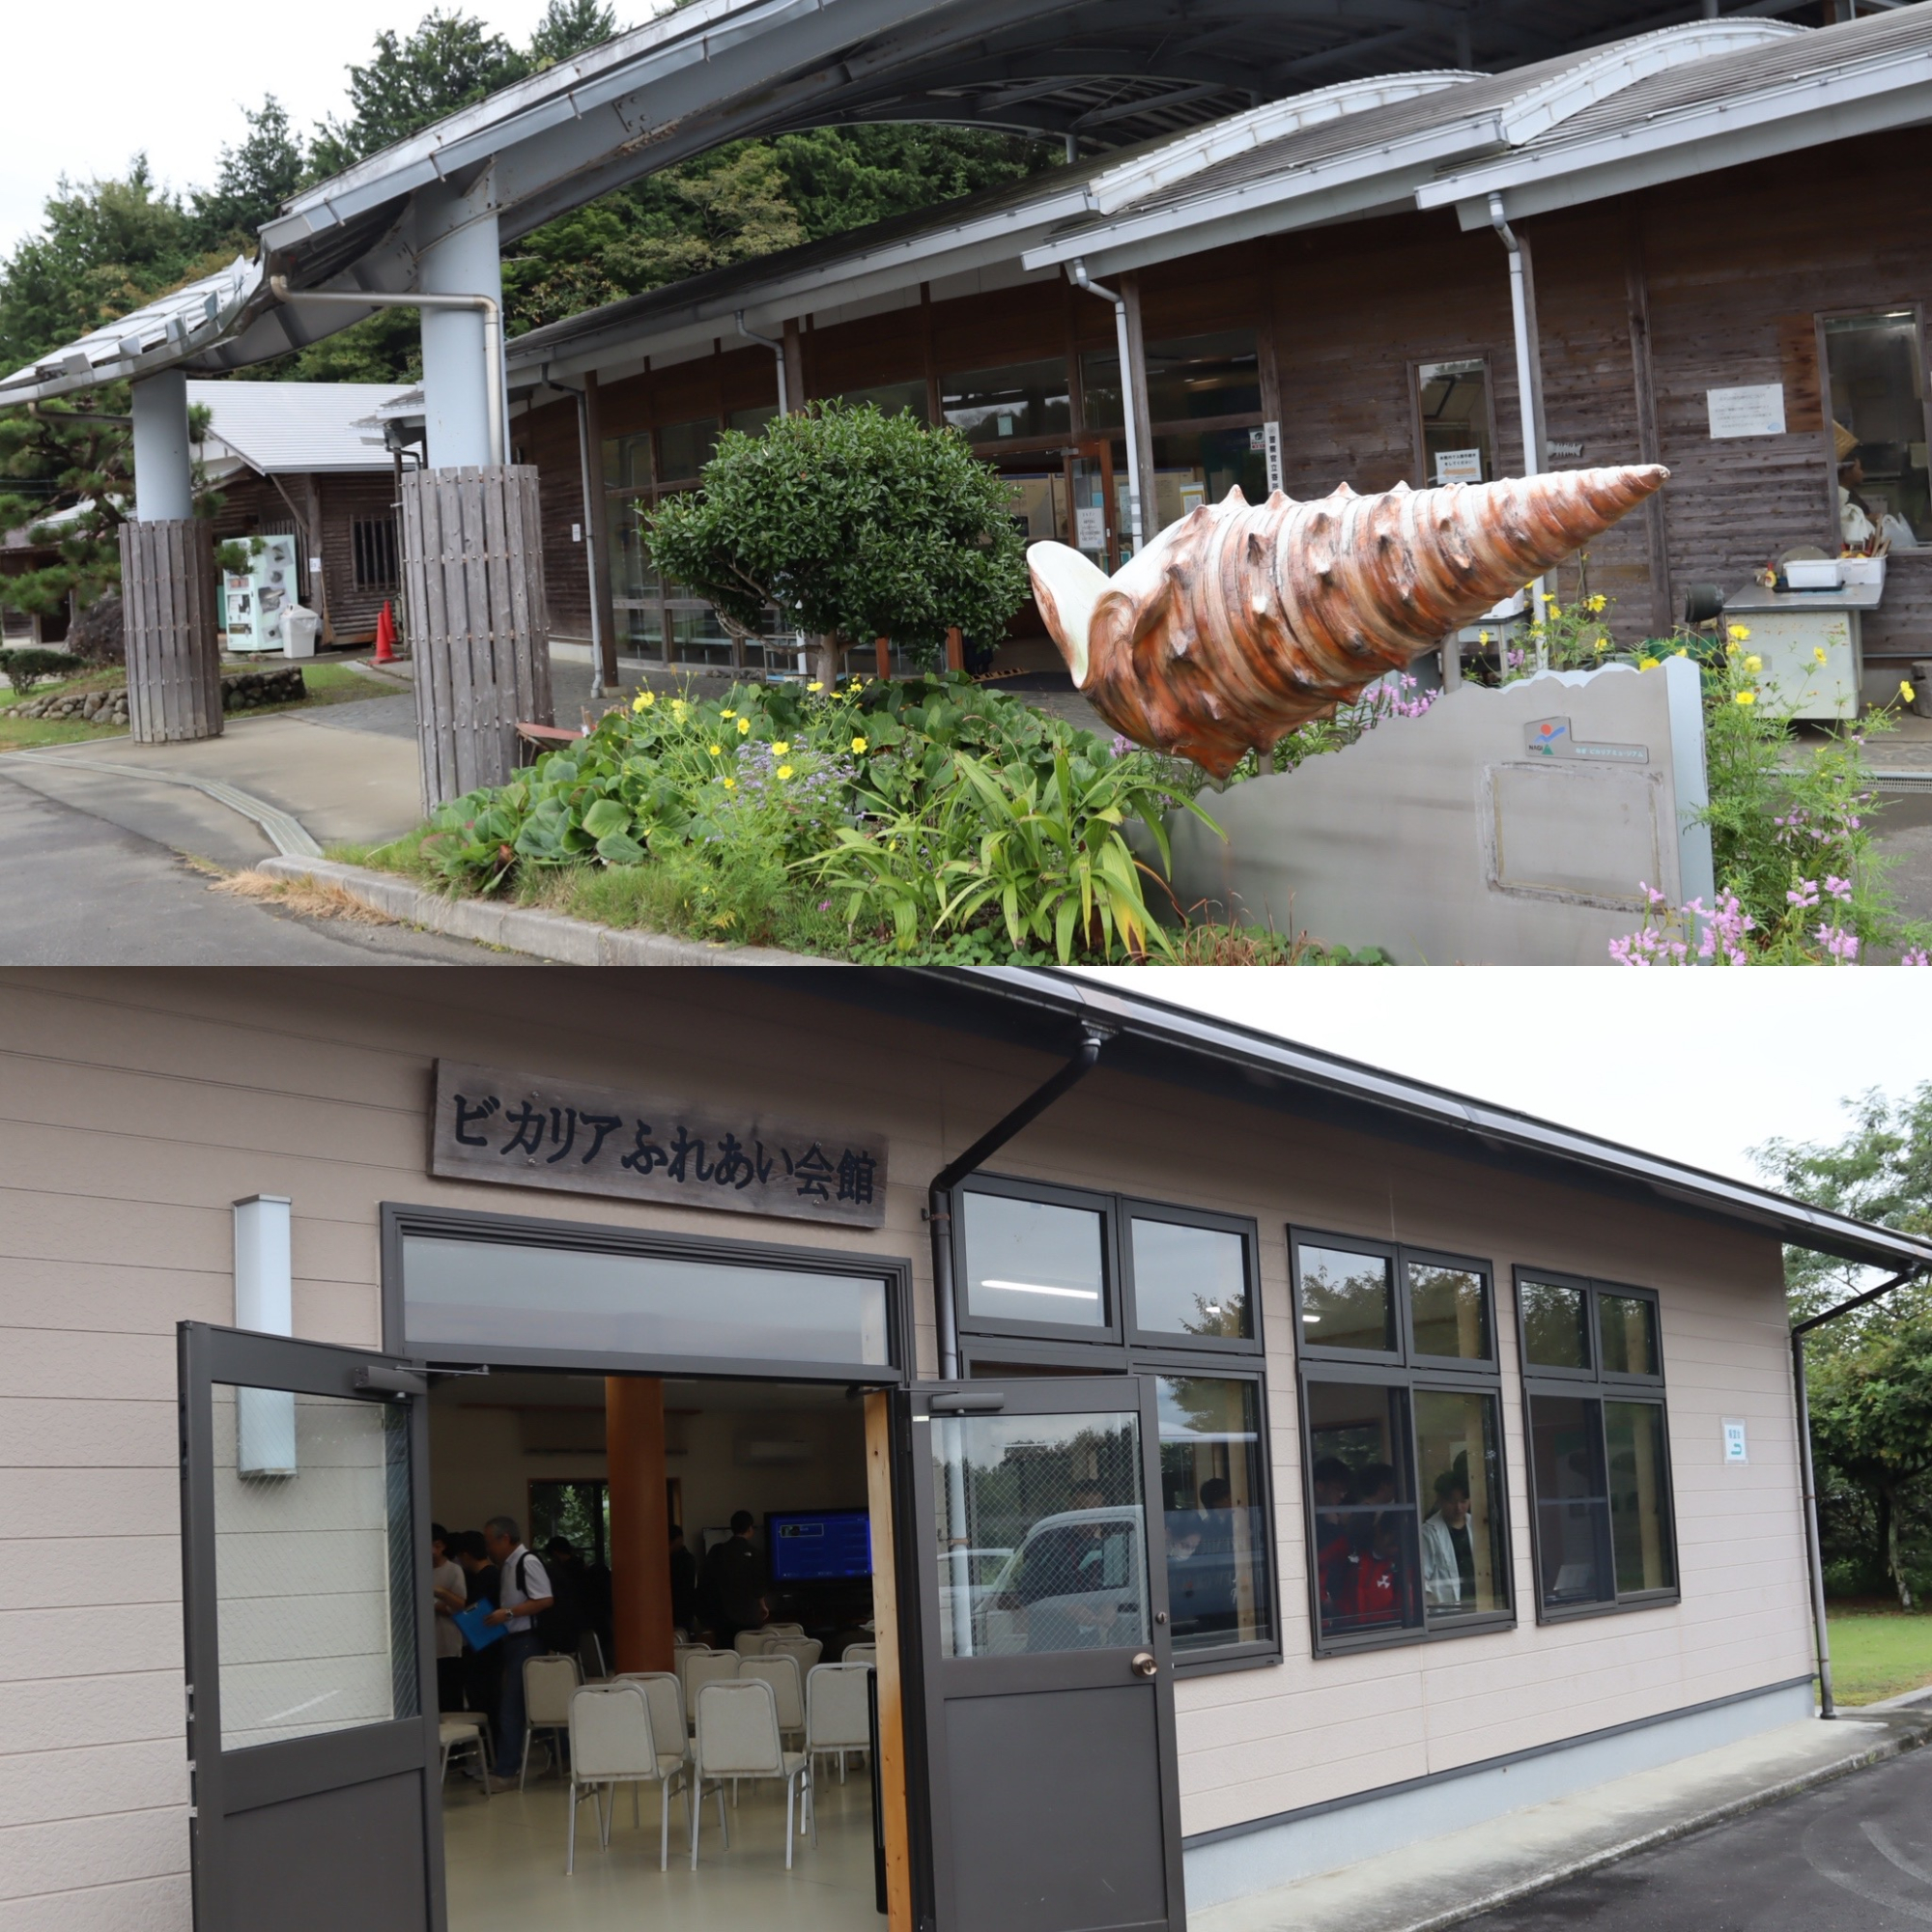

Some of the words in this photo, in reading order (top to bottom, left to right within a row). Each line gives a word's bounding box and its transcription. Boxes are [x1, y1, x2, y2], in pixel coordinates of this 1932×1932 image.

[1269, 435, 1279, 490] 警察官立寄所
[453, 1094, 877, 1206] ビカリアふれあい会館
